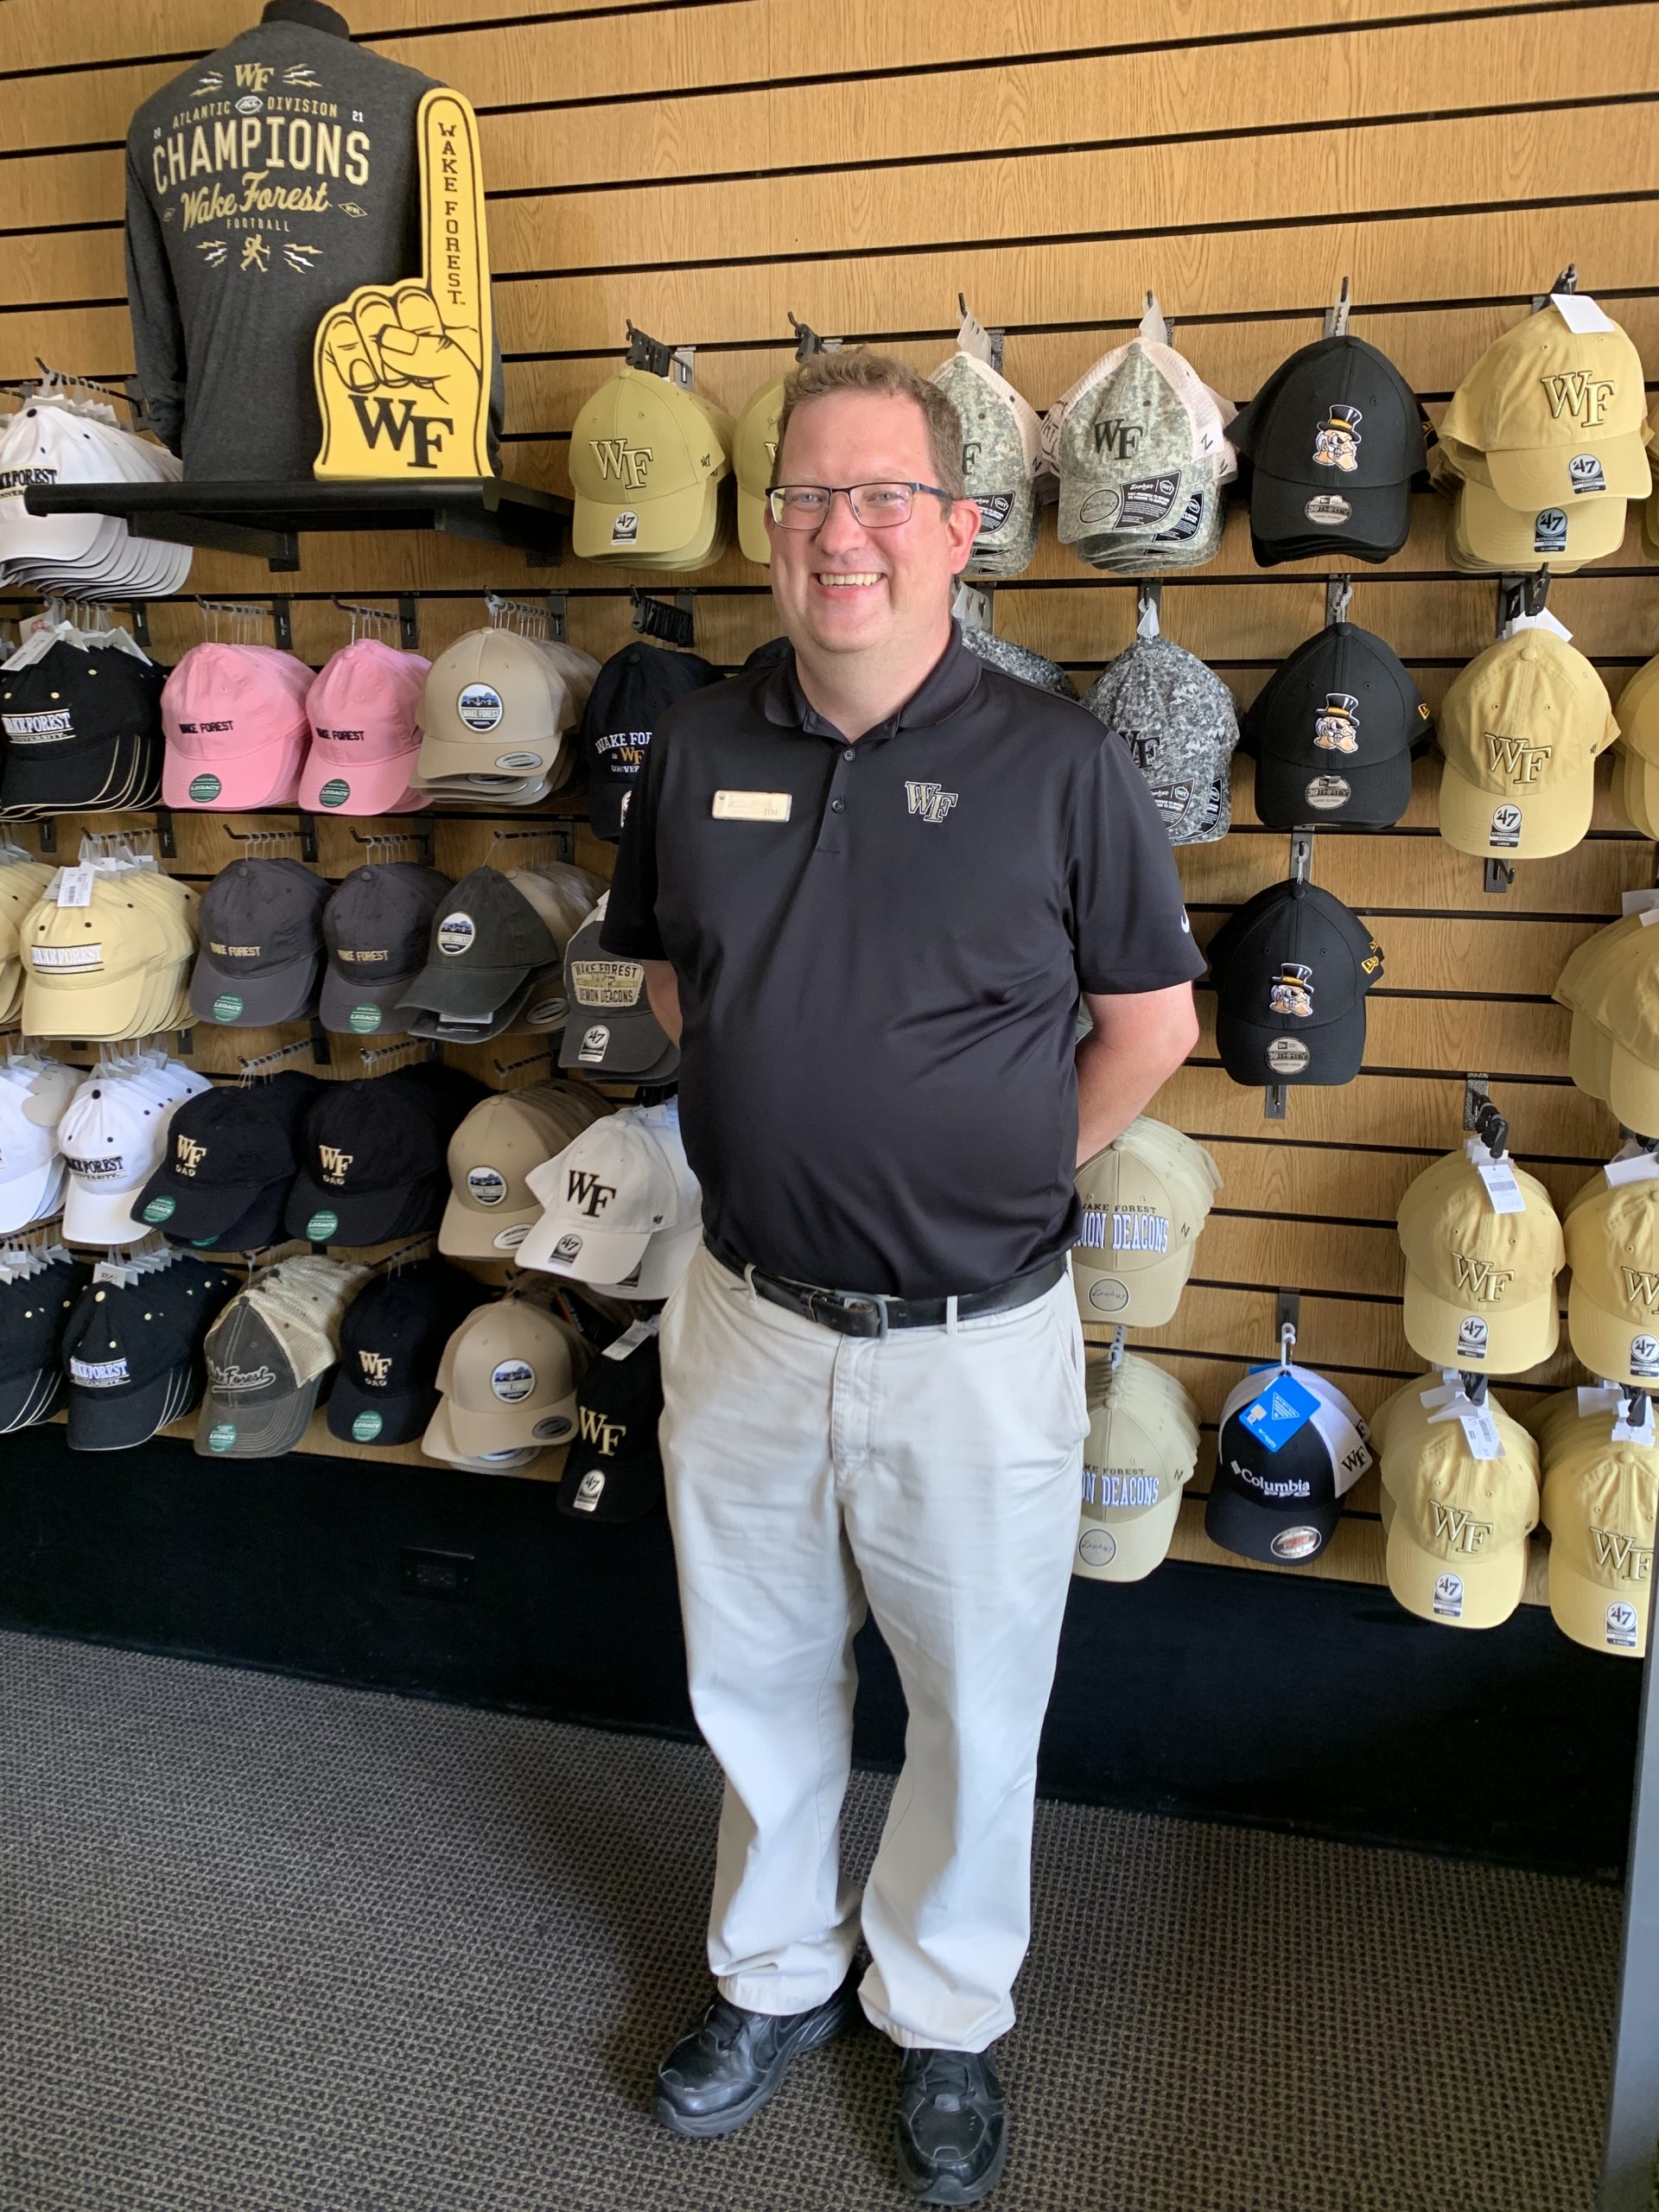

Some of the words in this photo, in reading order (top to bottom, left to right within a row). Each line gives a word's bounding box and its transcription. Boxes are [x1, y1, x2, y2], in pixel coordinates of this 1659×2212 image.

[235, 62, 274, 92] WF
[173, 101, 231, 129] ATLANTIC
[267, 96, 338, 118] DIVISION
[352, 111, 364, 123] 21
[153, 117, 371, 195] CHAMPIONS
[437, 122, 459, 194] WAKE
[181, 182, 238, 232] Wake
[239, 169, 333, 213] Forest
[226, 218, 290, 232] FOOTBALL
[444, 201, 464, 305] FOREST
[1541, 370, 1614, 428] WF
[348, 394, 454, 469] WF
[1095, 418, 1143, 461] WF
[588, 438, 653, 490] WF
[594, 732, 627, 754] WAKE
[620, 747, 645, 765] WF
[1484, 733, 1552, 785] WF
[905, 781, 958, 823] WF
[599, 963, 639, 978] FOREST
[177, 1134, 207, 1168] WF
[319, 1144, 353, 1177] WF
[568, 1169, 617, 1218] WF
[1115, 1204, 1156, 1214] FOREST
[1112, 1213, 1169, 1253] DEACONS
[1452, 1252, 1515, 1303] WF
[359, 1351, 392, 1379] WF
[579, 1406, 626, 1457] WF
[1103, 1466, 1145, 1476] FOREST
[1341, 1446, 1366, 1472] WF
[1102, 1475, 1160, 1507] DEACONS
[1242, 1468, 1311, 1492] Columbia
[1429, 1499, 1493, 1554] WF
[1590, 1527, 1654, 1581] WF
